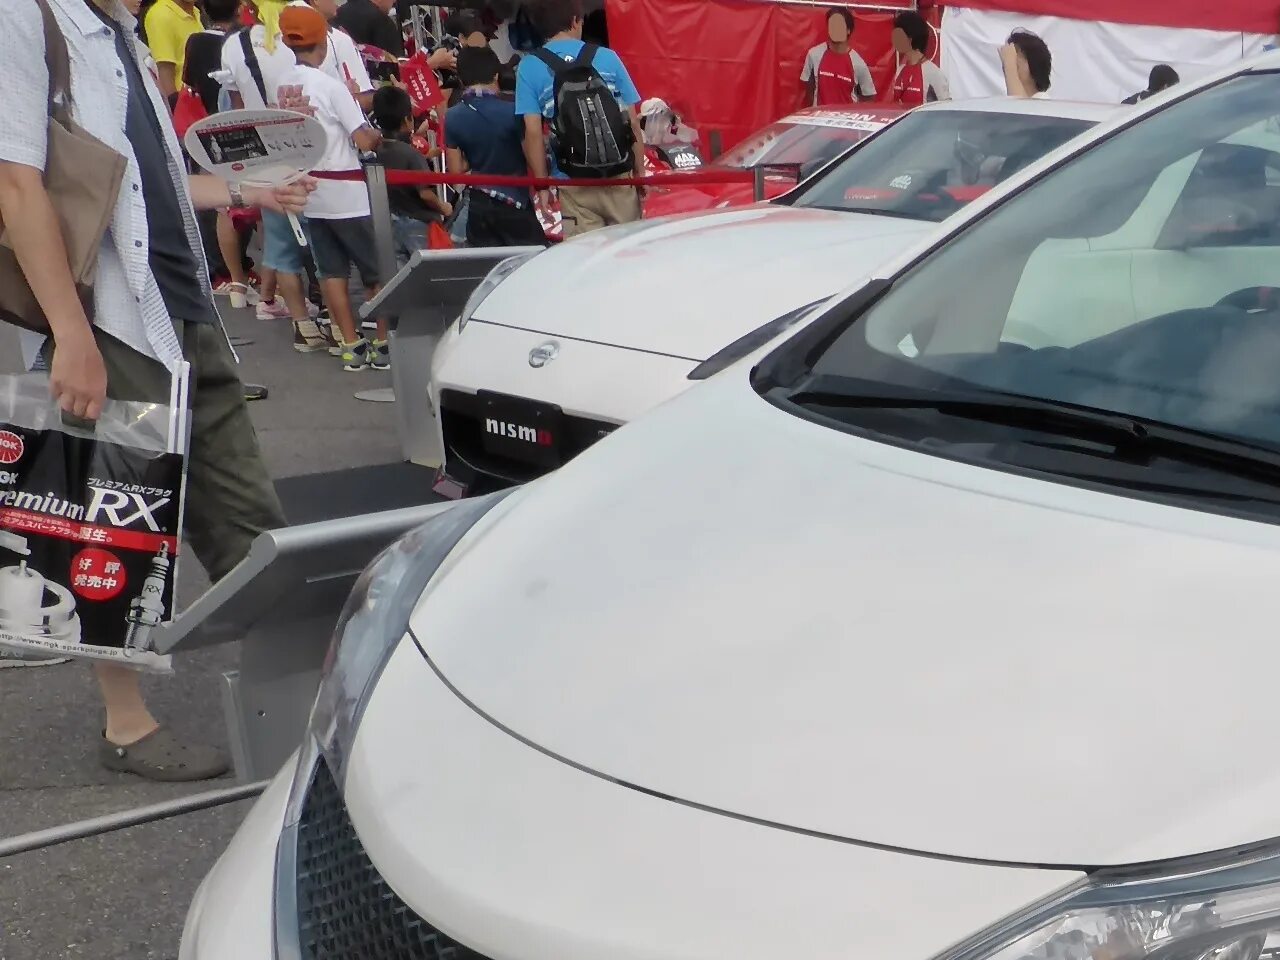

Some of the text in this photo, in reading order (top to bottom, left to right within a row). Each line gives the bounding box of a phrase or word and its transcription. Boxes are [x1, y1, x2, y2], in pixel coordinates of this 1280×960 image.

[486, 418, 553, 446] nismo
[0, 471, 19, 485] GK
[87, 477, 173, 498] プレミアムRXプラグ
[0, 490, 84, 521] remium
[85, 486, 171, 532] RX
[74, 573, 118, 590] 発売中
[144, 584, 161, 595] RX
